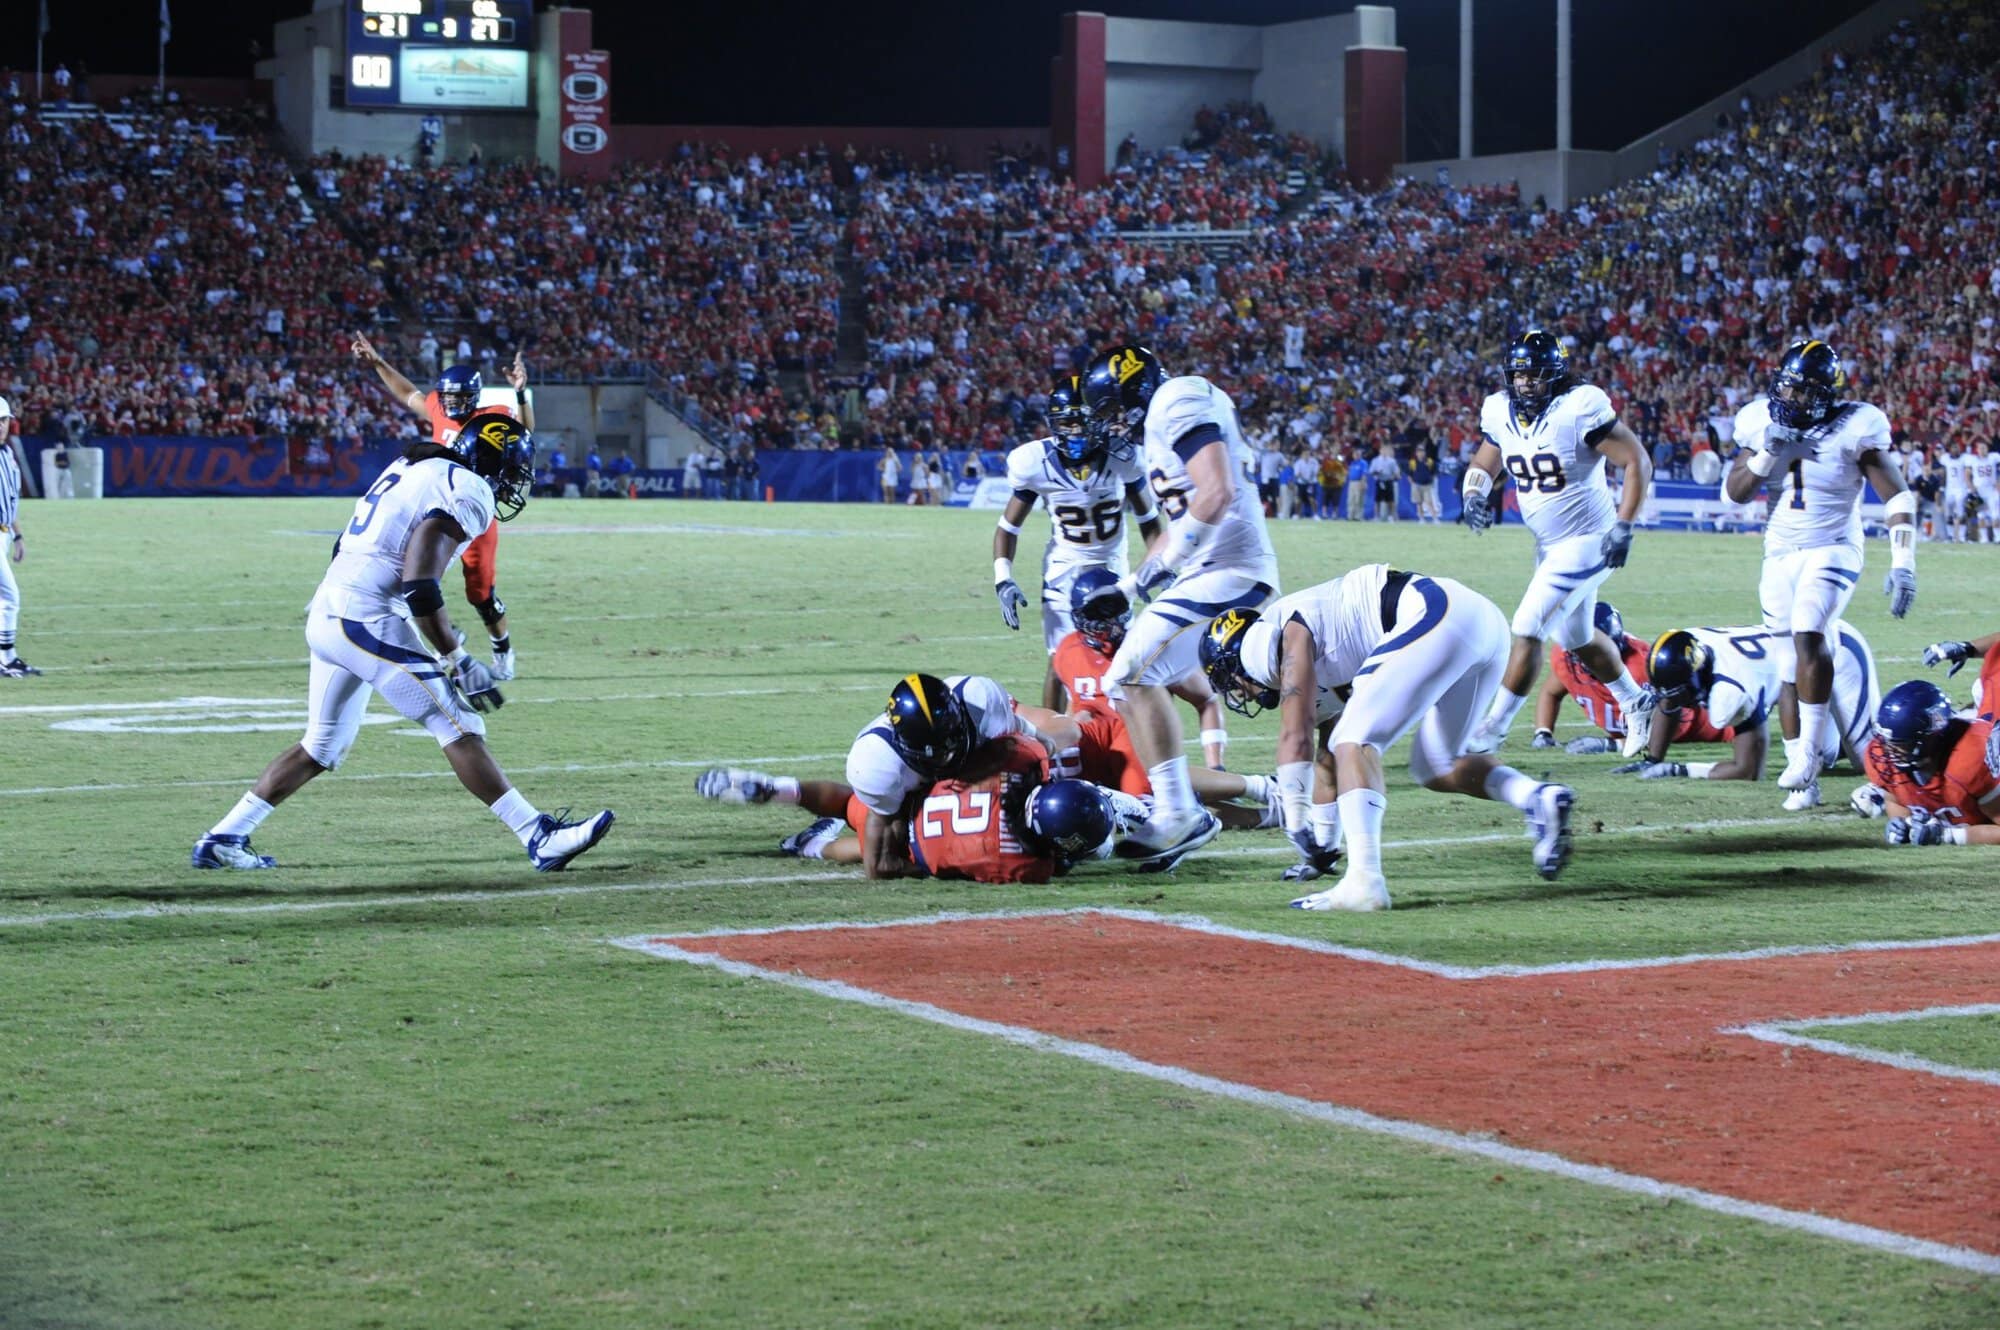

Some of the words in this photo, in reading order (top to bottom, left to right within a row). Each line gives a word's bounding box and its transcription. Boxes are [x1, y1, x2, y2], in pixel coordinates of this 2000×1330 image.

[1109, 349, 1145, 385] Cal
[1506, 452, 1567, 494] 98
[1789, 458, 1806, 511] 1
[1054, 500, 1122, 544] 26
[1211, 609, 1246, 648] Cal
[922, 790, 994, 839] 2
